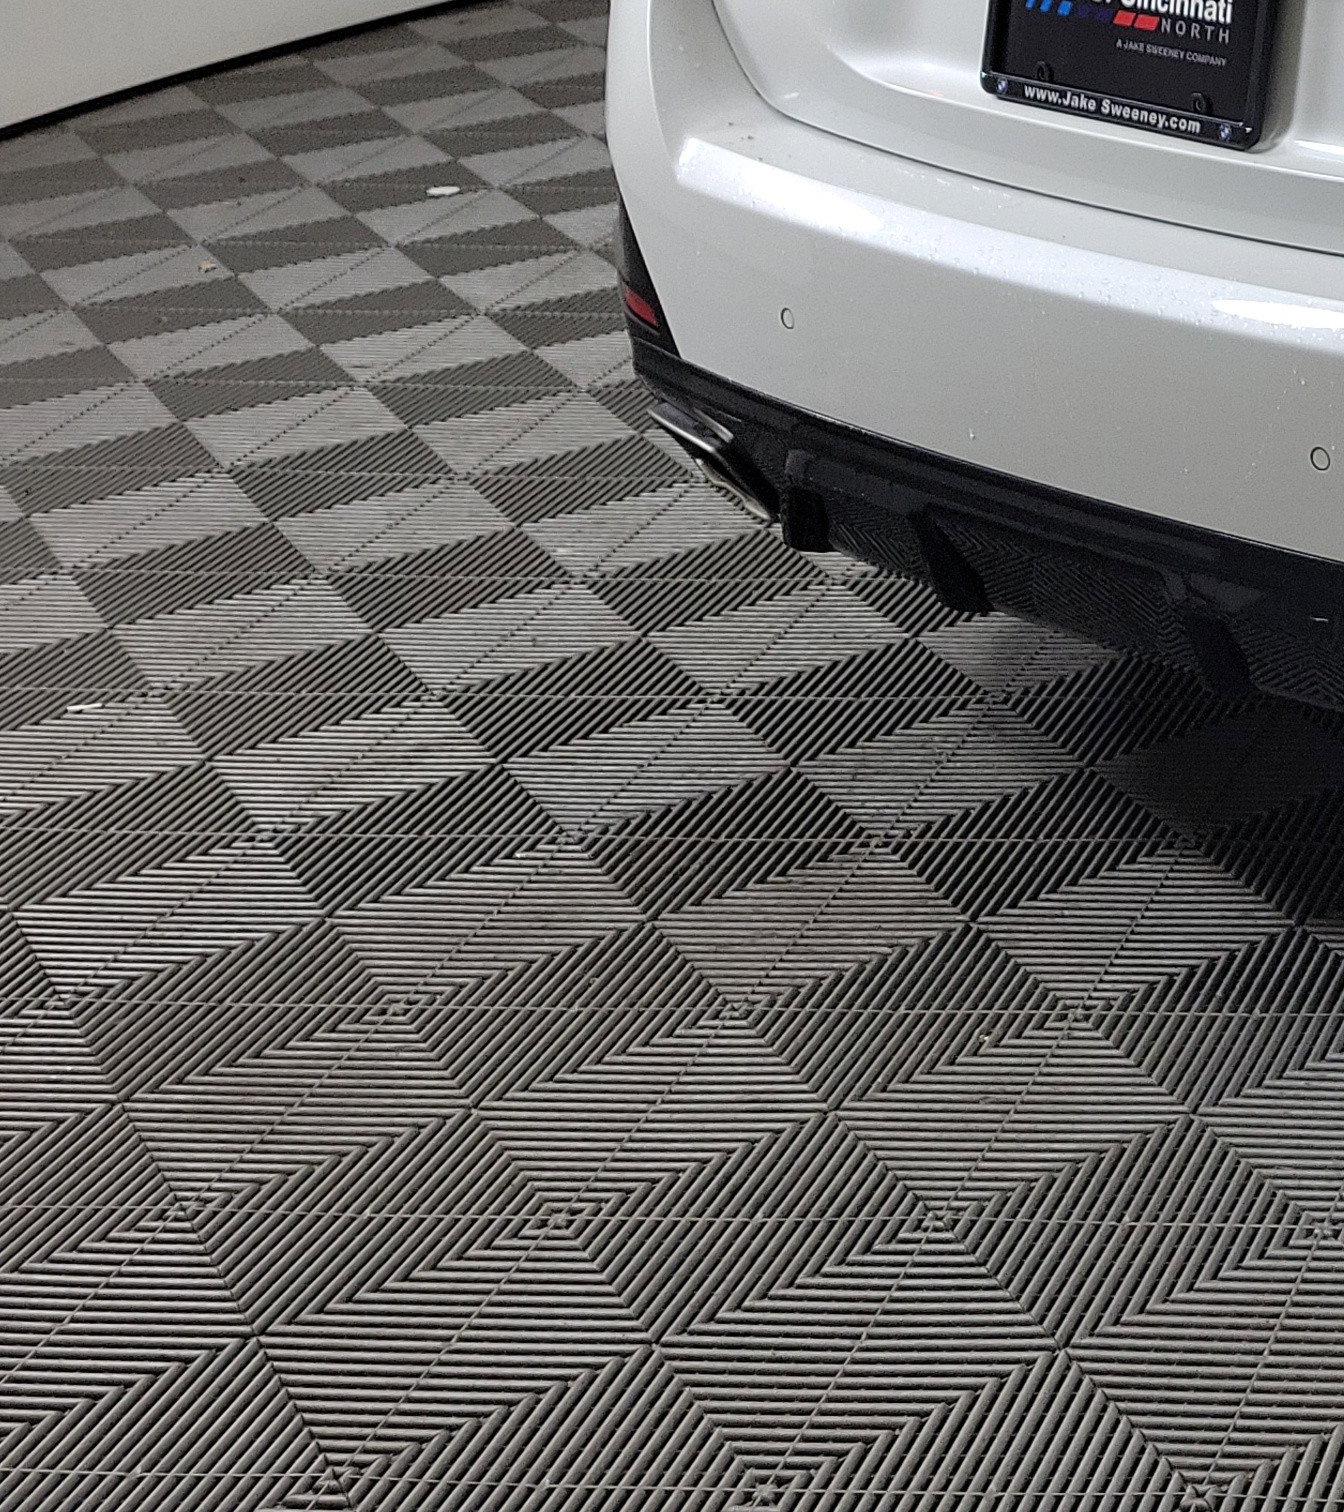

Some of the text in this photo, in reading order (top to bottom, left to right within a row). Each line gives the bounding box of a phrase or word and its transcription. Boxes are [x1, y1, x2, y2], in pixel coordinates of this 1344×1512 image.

[1161, 17, 1230, 44] NORTH
[1116, 38, 1227, 67] A JAKE SWEENEY COMPANY
[1101, 99, 1201, 134] Sweeney.com
